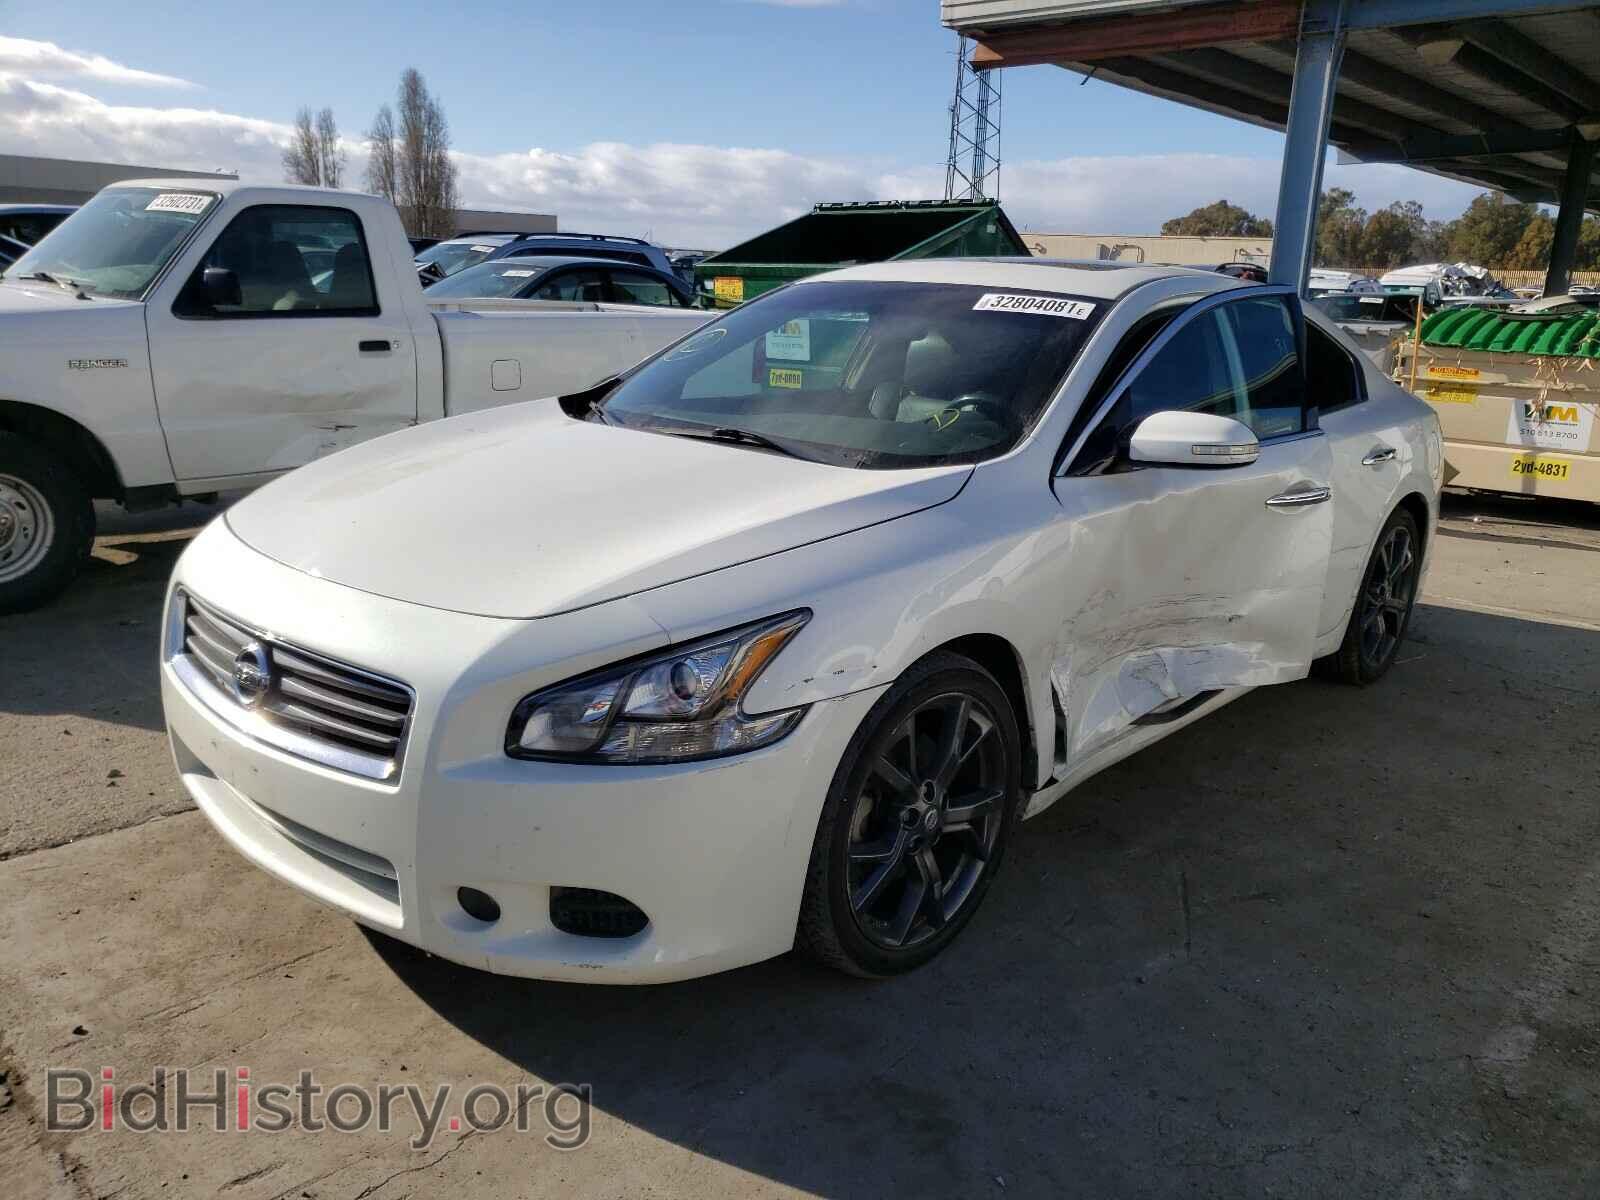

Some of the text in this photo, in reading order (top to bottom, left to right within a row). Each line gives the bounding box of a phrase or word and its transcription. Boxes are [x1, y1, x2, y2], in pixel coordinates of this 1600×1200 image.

[990, 295, 1077, 314] 32804081
[68, 359, 129, 369] RANGER
[1512, 459, 1568, 478] 2yd-4831
